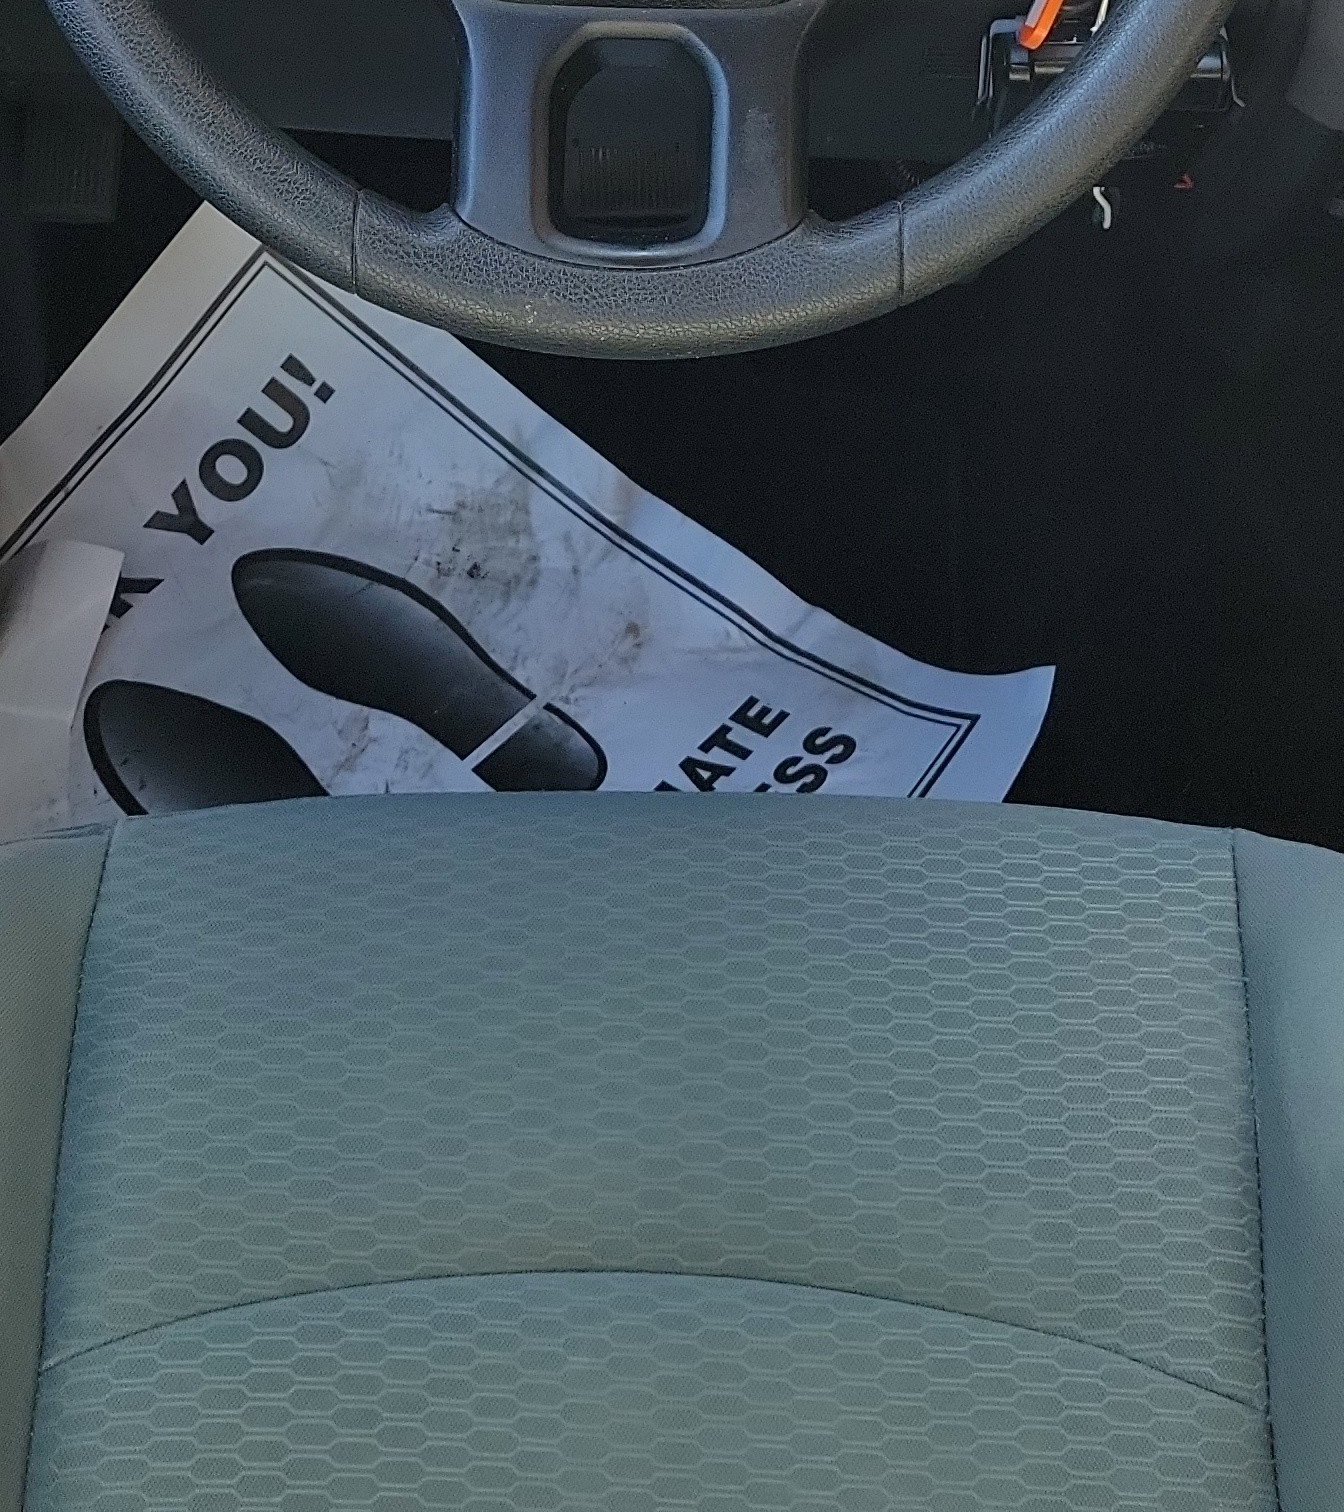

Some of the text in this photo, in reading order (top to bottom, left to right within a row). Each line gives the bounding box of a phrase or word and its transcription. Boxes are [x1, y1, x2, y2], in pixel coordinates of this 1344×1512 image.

[143, 353, 336, 546] YOU!
[654, 695, 791, 793] ATE
[754, 726, 857, 794] SS
